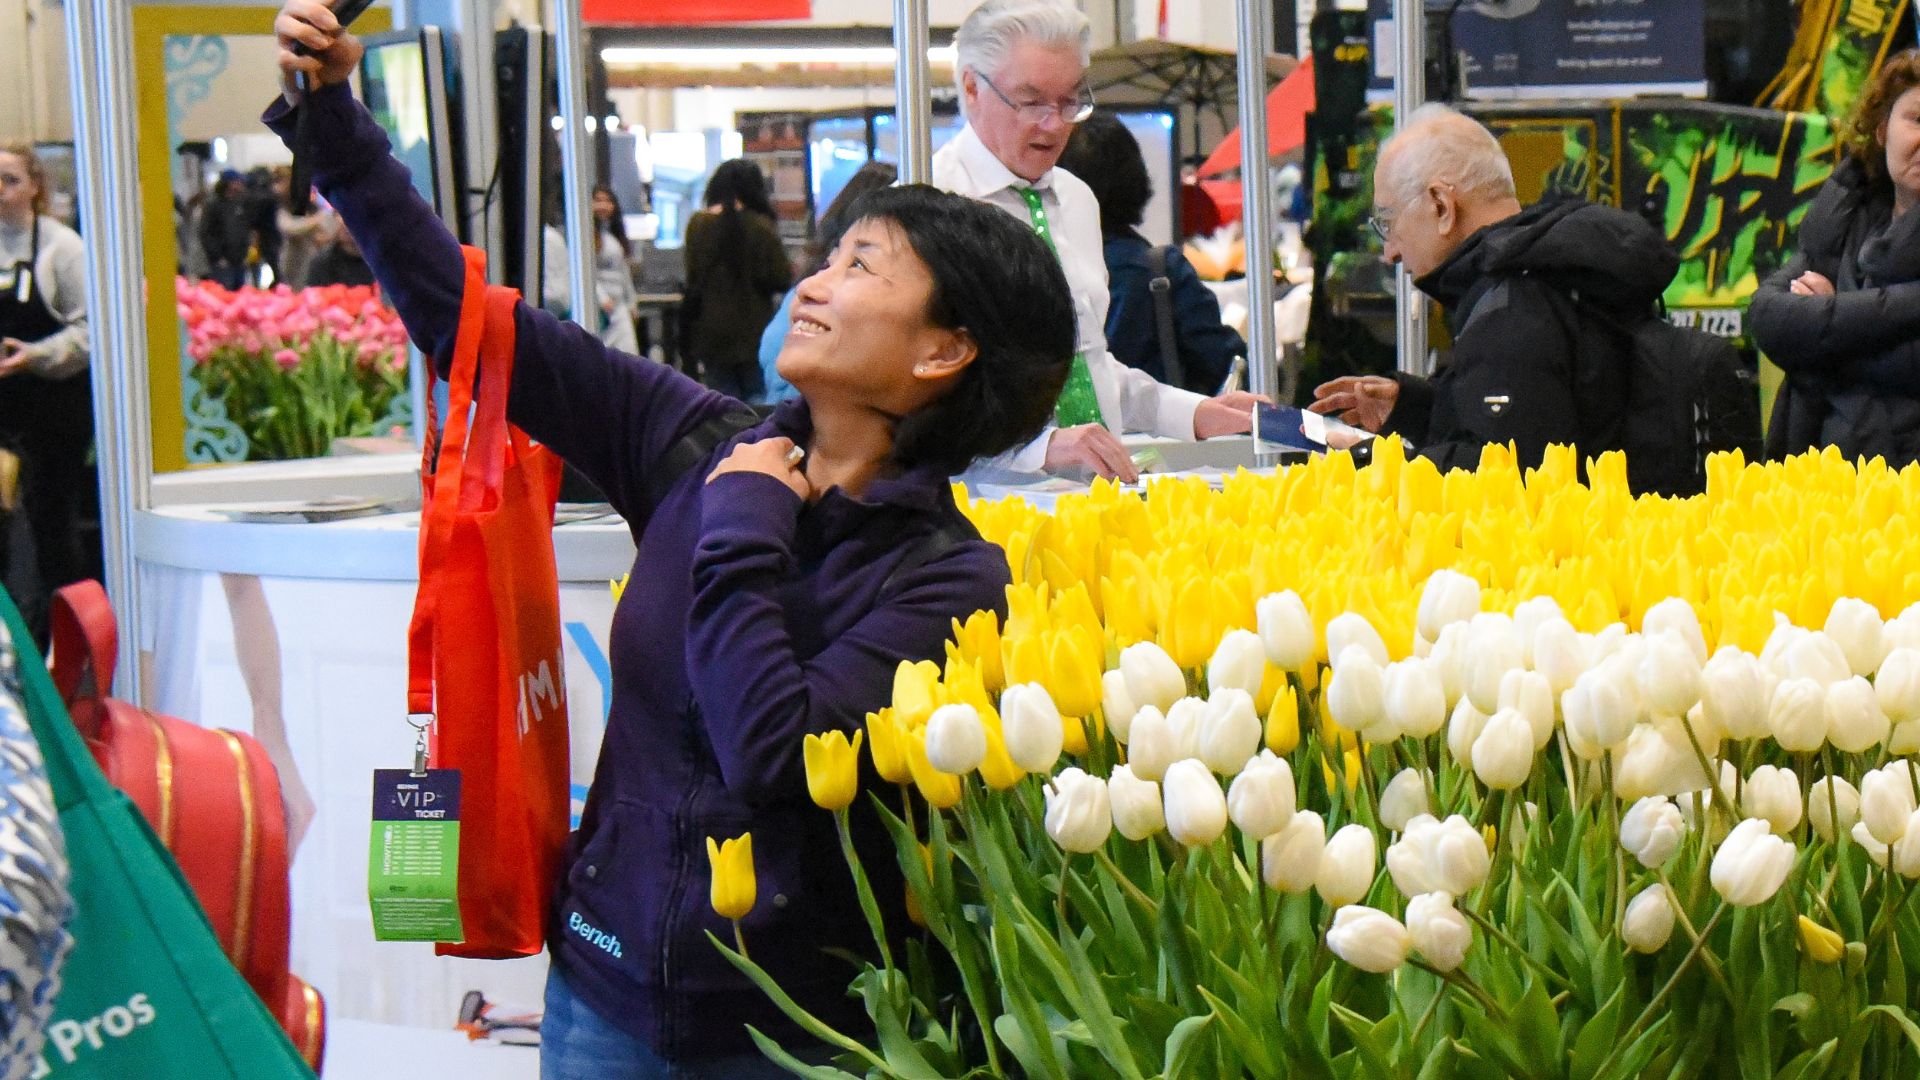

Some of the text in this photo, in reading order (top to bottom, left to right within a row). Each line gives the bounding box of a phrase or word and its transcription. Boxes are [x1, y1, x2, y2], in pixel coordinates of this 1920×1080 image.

[396, 791, 436, 807] VIP
[414, 809, 446, 818] TICKET
[50, 992, 155, 1063] Pros
